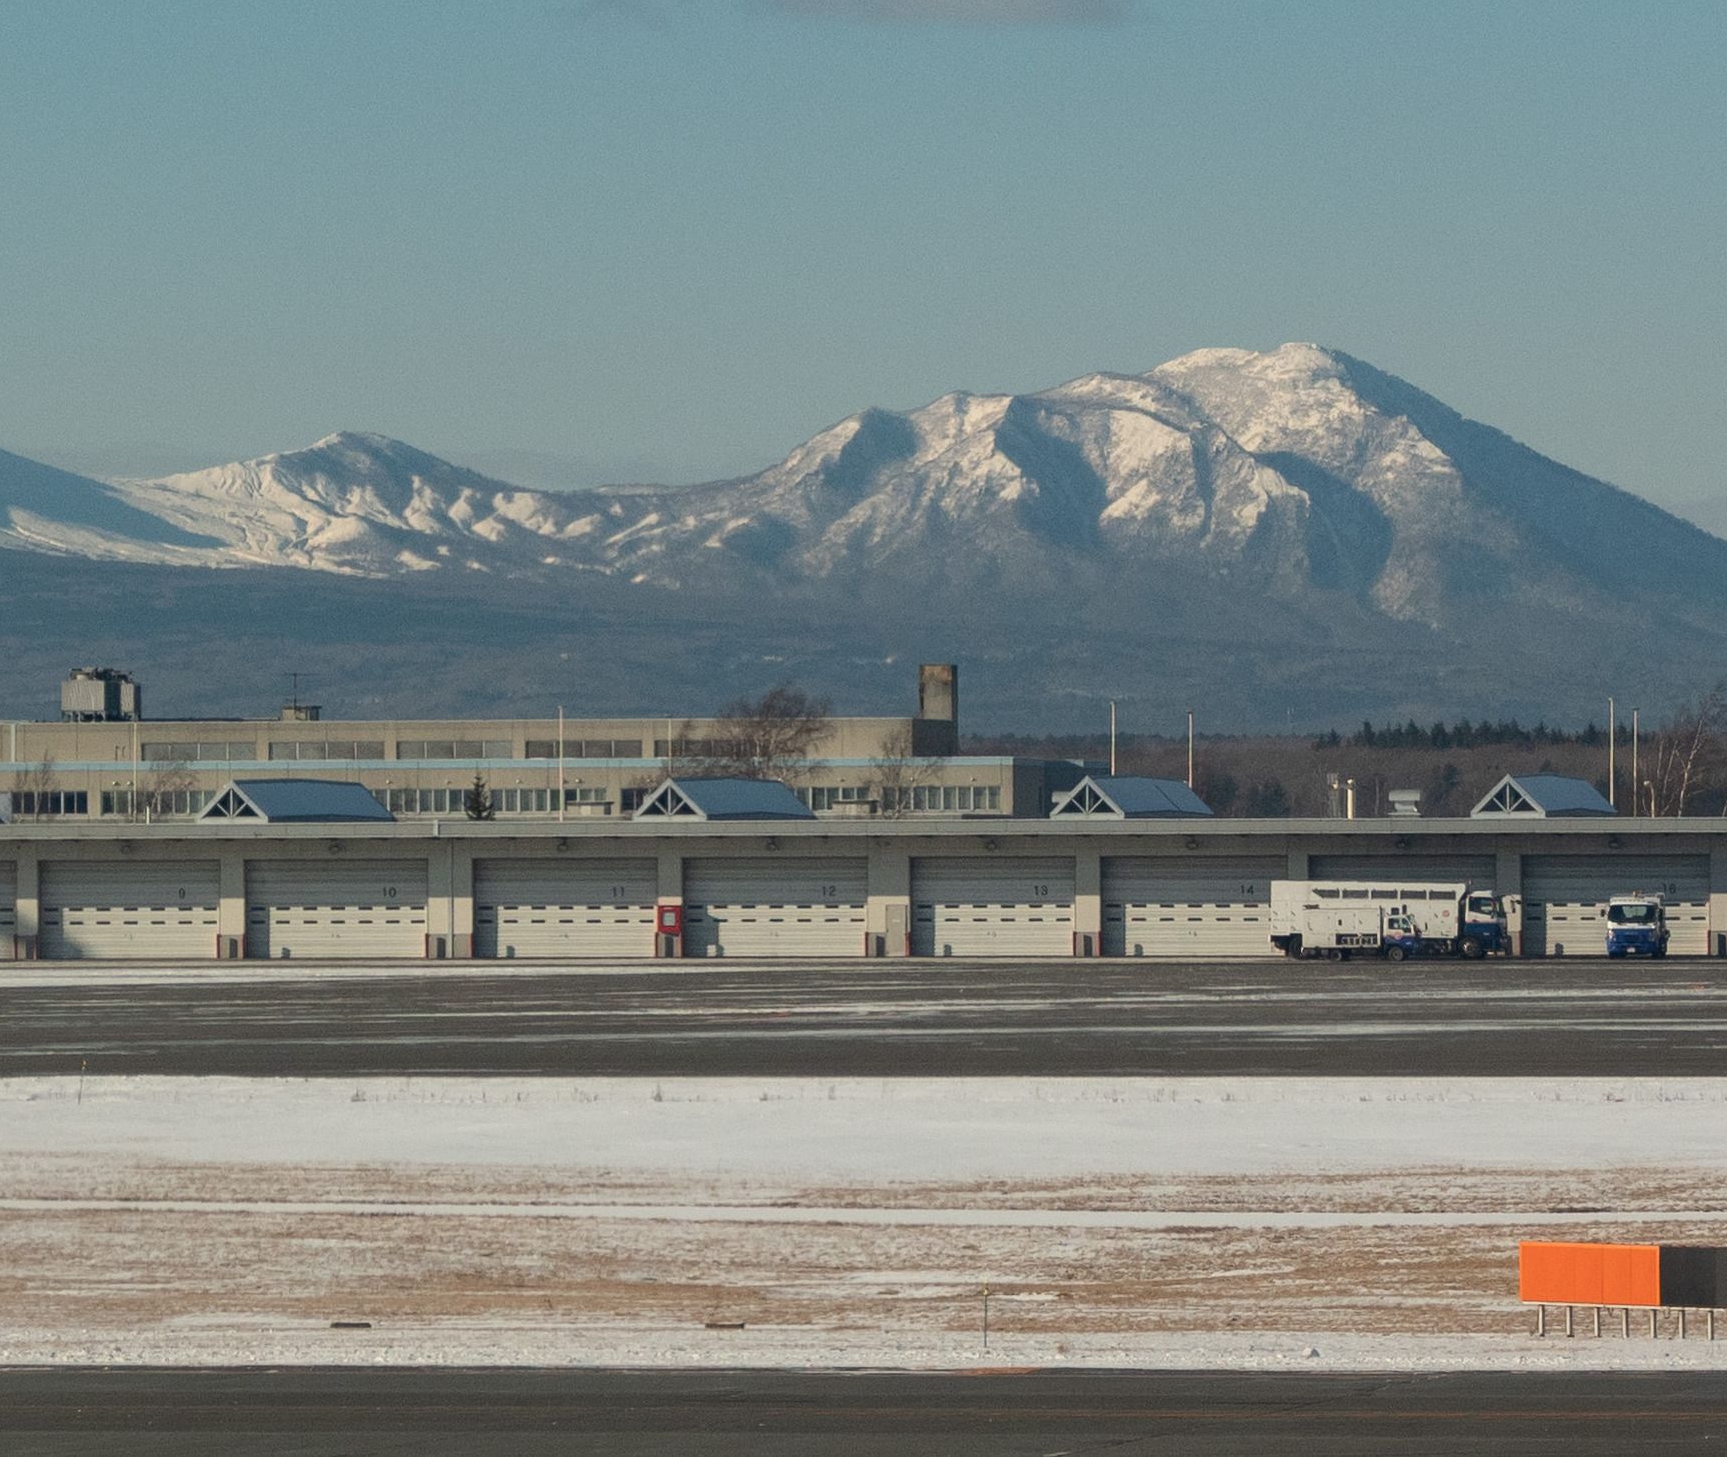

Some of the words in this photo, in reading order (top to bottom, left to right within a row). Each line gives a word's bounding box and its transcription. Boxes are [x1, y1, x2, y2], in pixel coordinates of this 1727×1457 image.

[382, 887, 397, 898] 10
[612, 886, 625, 898] 11
[822, 885, 836, 897] 12
[1034, 885, 1048, 896] 13
[1240, 885, 1254, 895] 14
